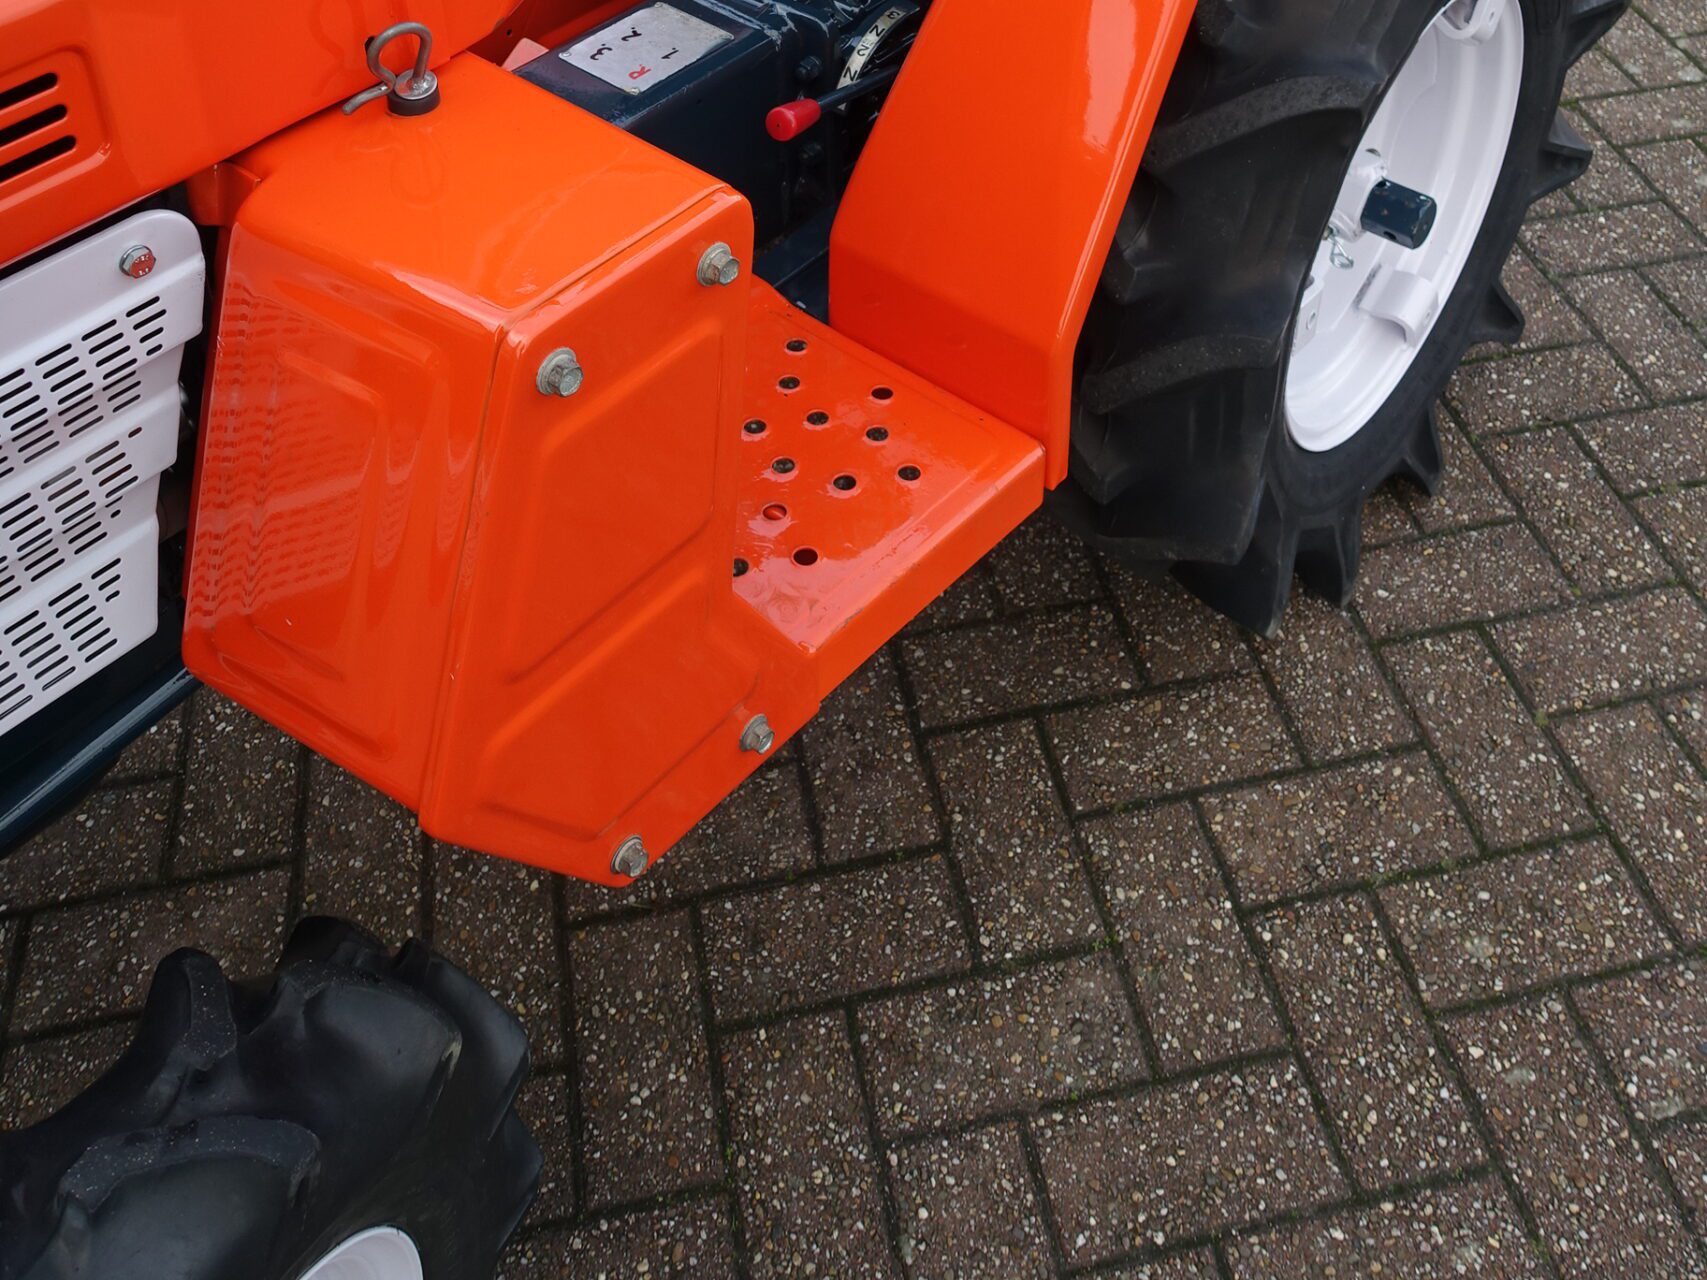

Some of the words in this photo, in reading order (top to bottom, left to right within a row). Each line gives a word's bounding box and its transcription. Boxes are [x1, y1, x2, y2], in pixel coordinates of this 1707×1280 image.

[869, 24, 886, 37] N
[857, 43, 870, 57] 2
[843, 66, 858, 82] N
